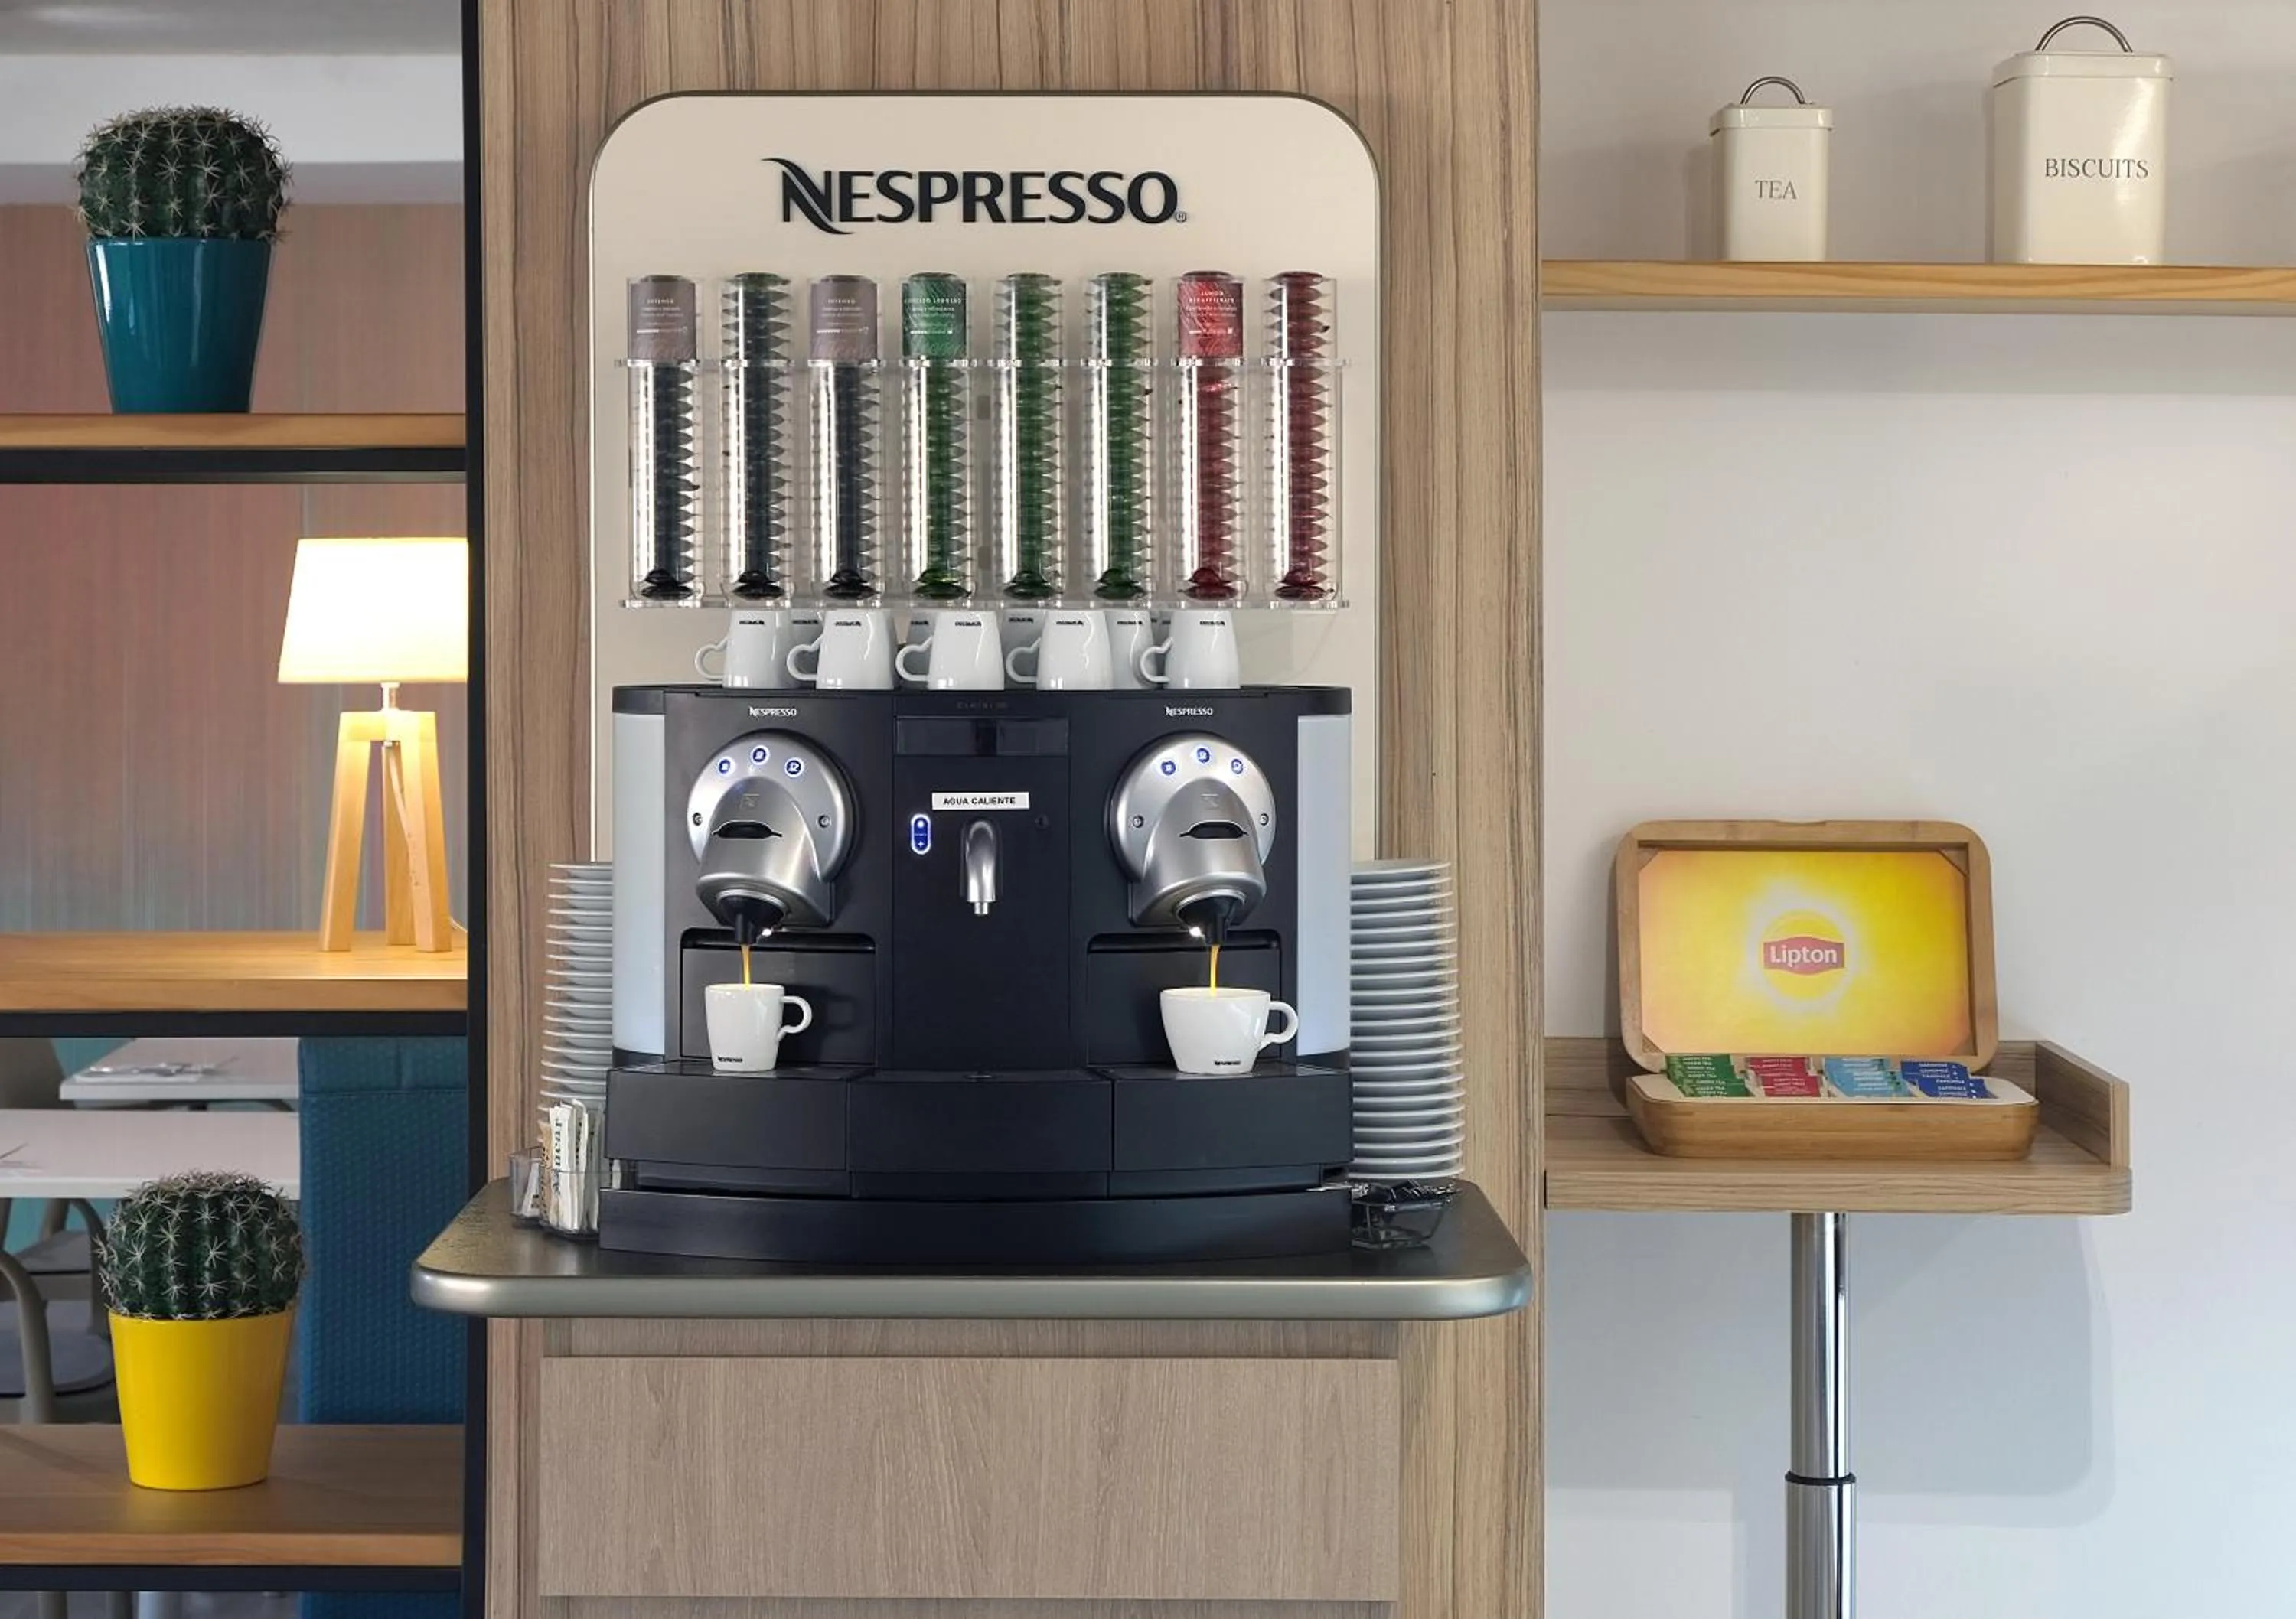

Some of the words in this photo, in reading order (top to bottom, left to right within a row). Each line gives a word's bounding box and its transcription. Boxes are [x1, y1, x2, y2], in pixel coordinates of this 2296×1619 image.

[2044, 158, 2149, 178] BISCUITS
[761, 158, 1179, 234] NESPRESSO
[1755, 180, 1797, 200] TEA
[749, 707, 797, 717] NESPRESSO
[1166, 707, 1213, 716] NESPRESSO
[1770, 944, 1838, 968] Lipton
